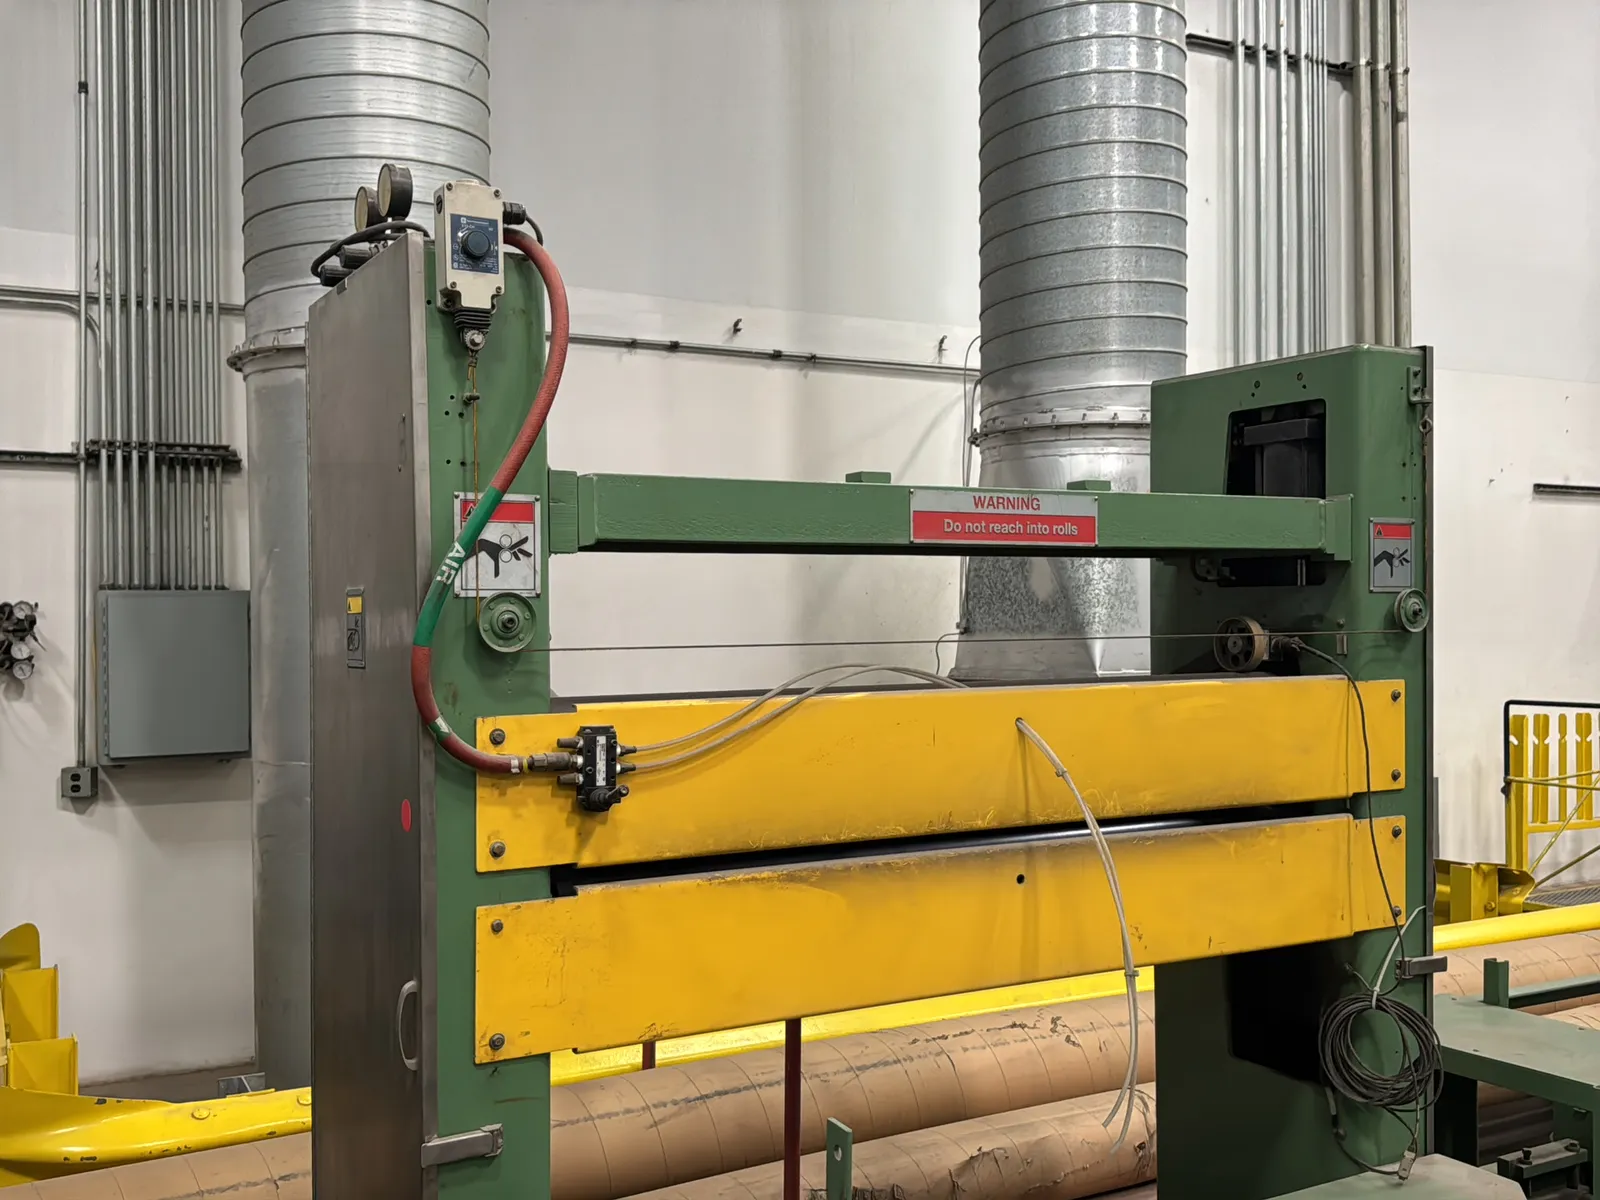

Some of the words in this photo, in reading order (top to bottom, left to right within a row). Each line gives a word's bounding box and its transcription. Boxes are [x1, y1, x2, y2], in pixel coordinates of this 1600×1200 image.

[973, 495, 1041, 511] WARNING
[944, 519, 961, 533] Do
[966, 521, 986, 534] not
[989, 520, 1024, 534] reach
[1027, 521, 1050, 535] into
[1053, 522, 1078, 536] rolls
[436, 541, 466, 585] AIR
